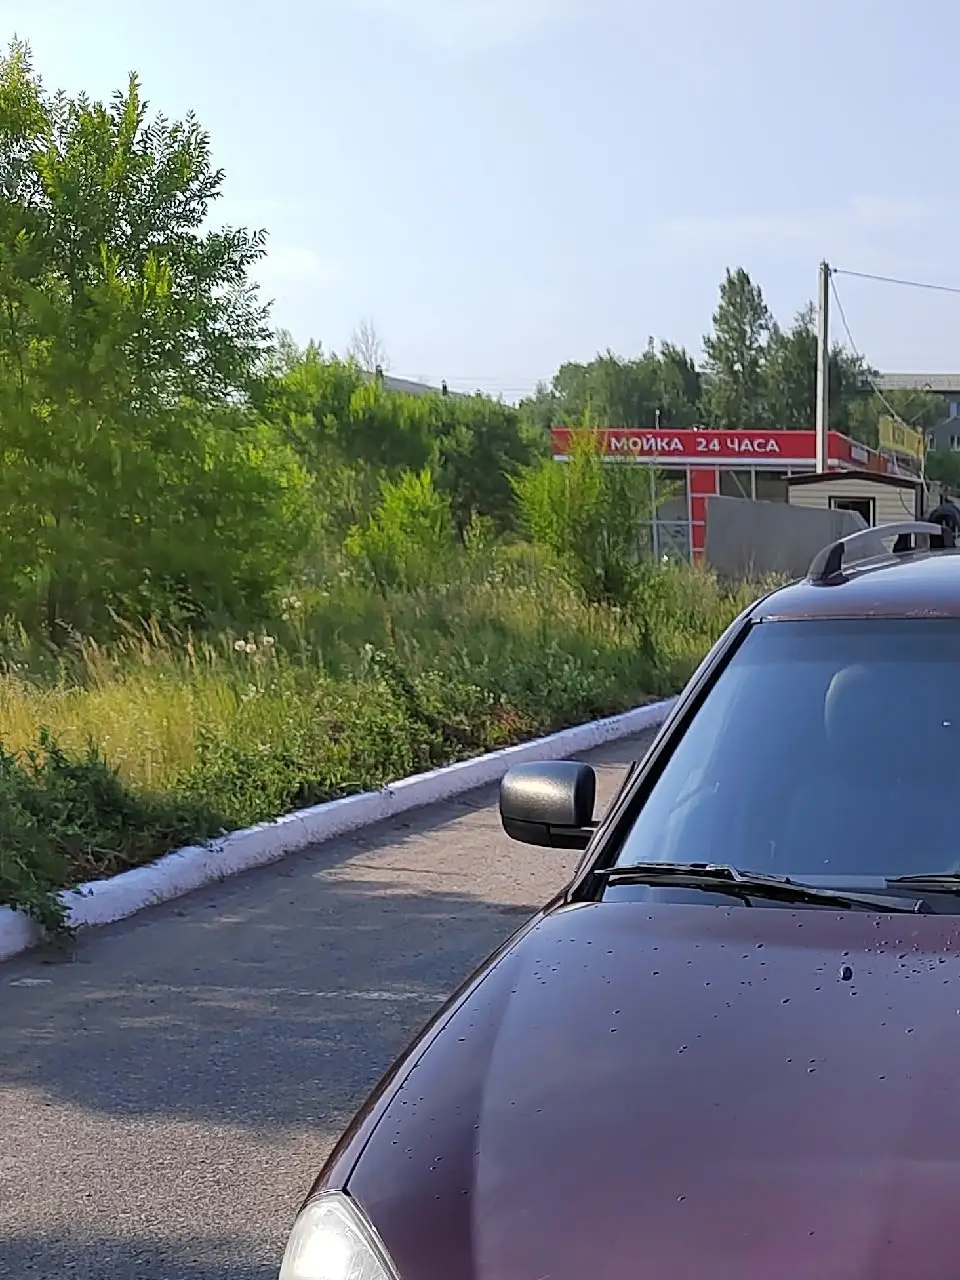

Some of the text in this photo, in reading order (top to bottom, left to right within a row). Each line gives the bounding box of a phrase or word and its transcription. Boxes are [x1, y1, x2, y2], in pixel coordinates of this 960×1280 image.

[610, 434, 781, 453] МОЙКА 24 ЧАСА
